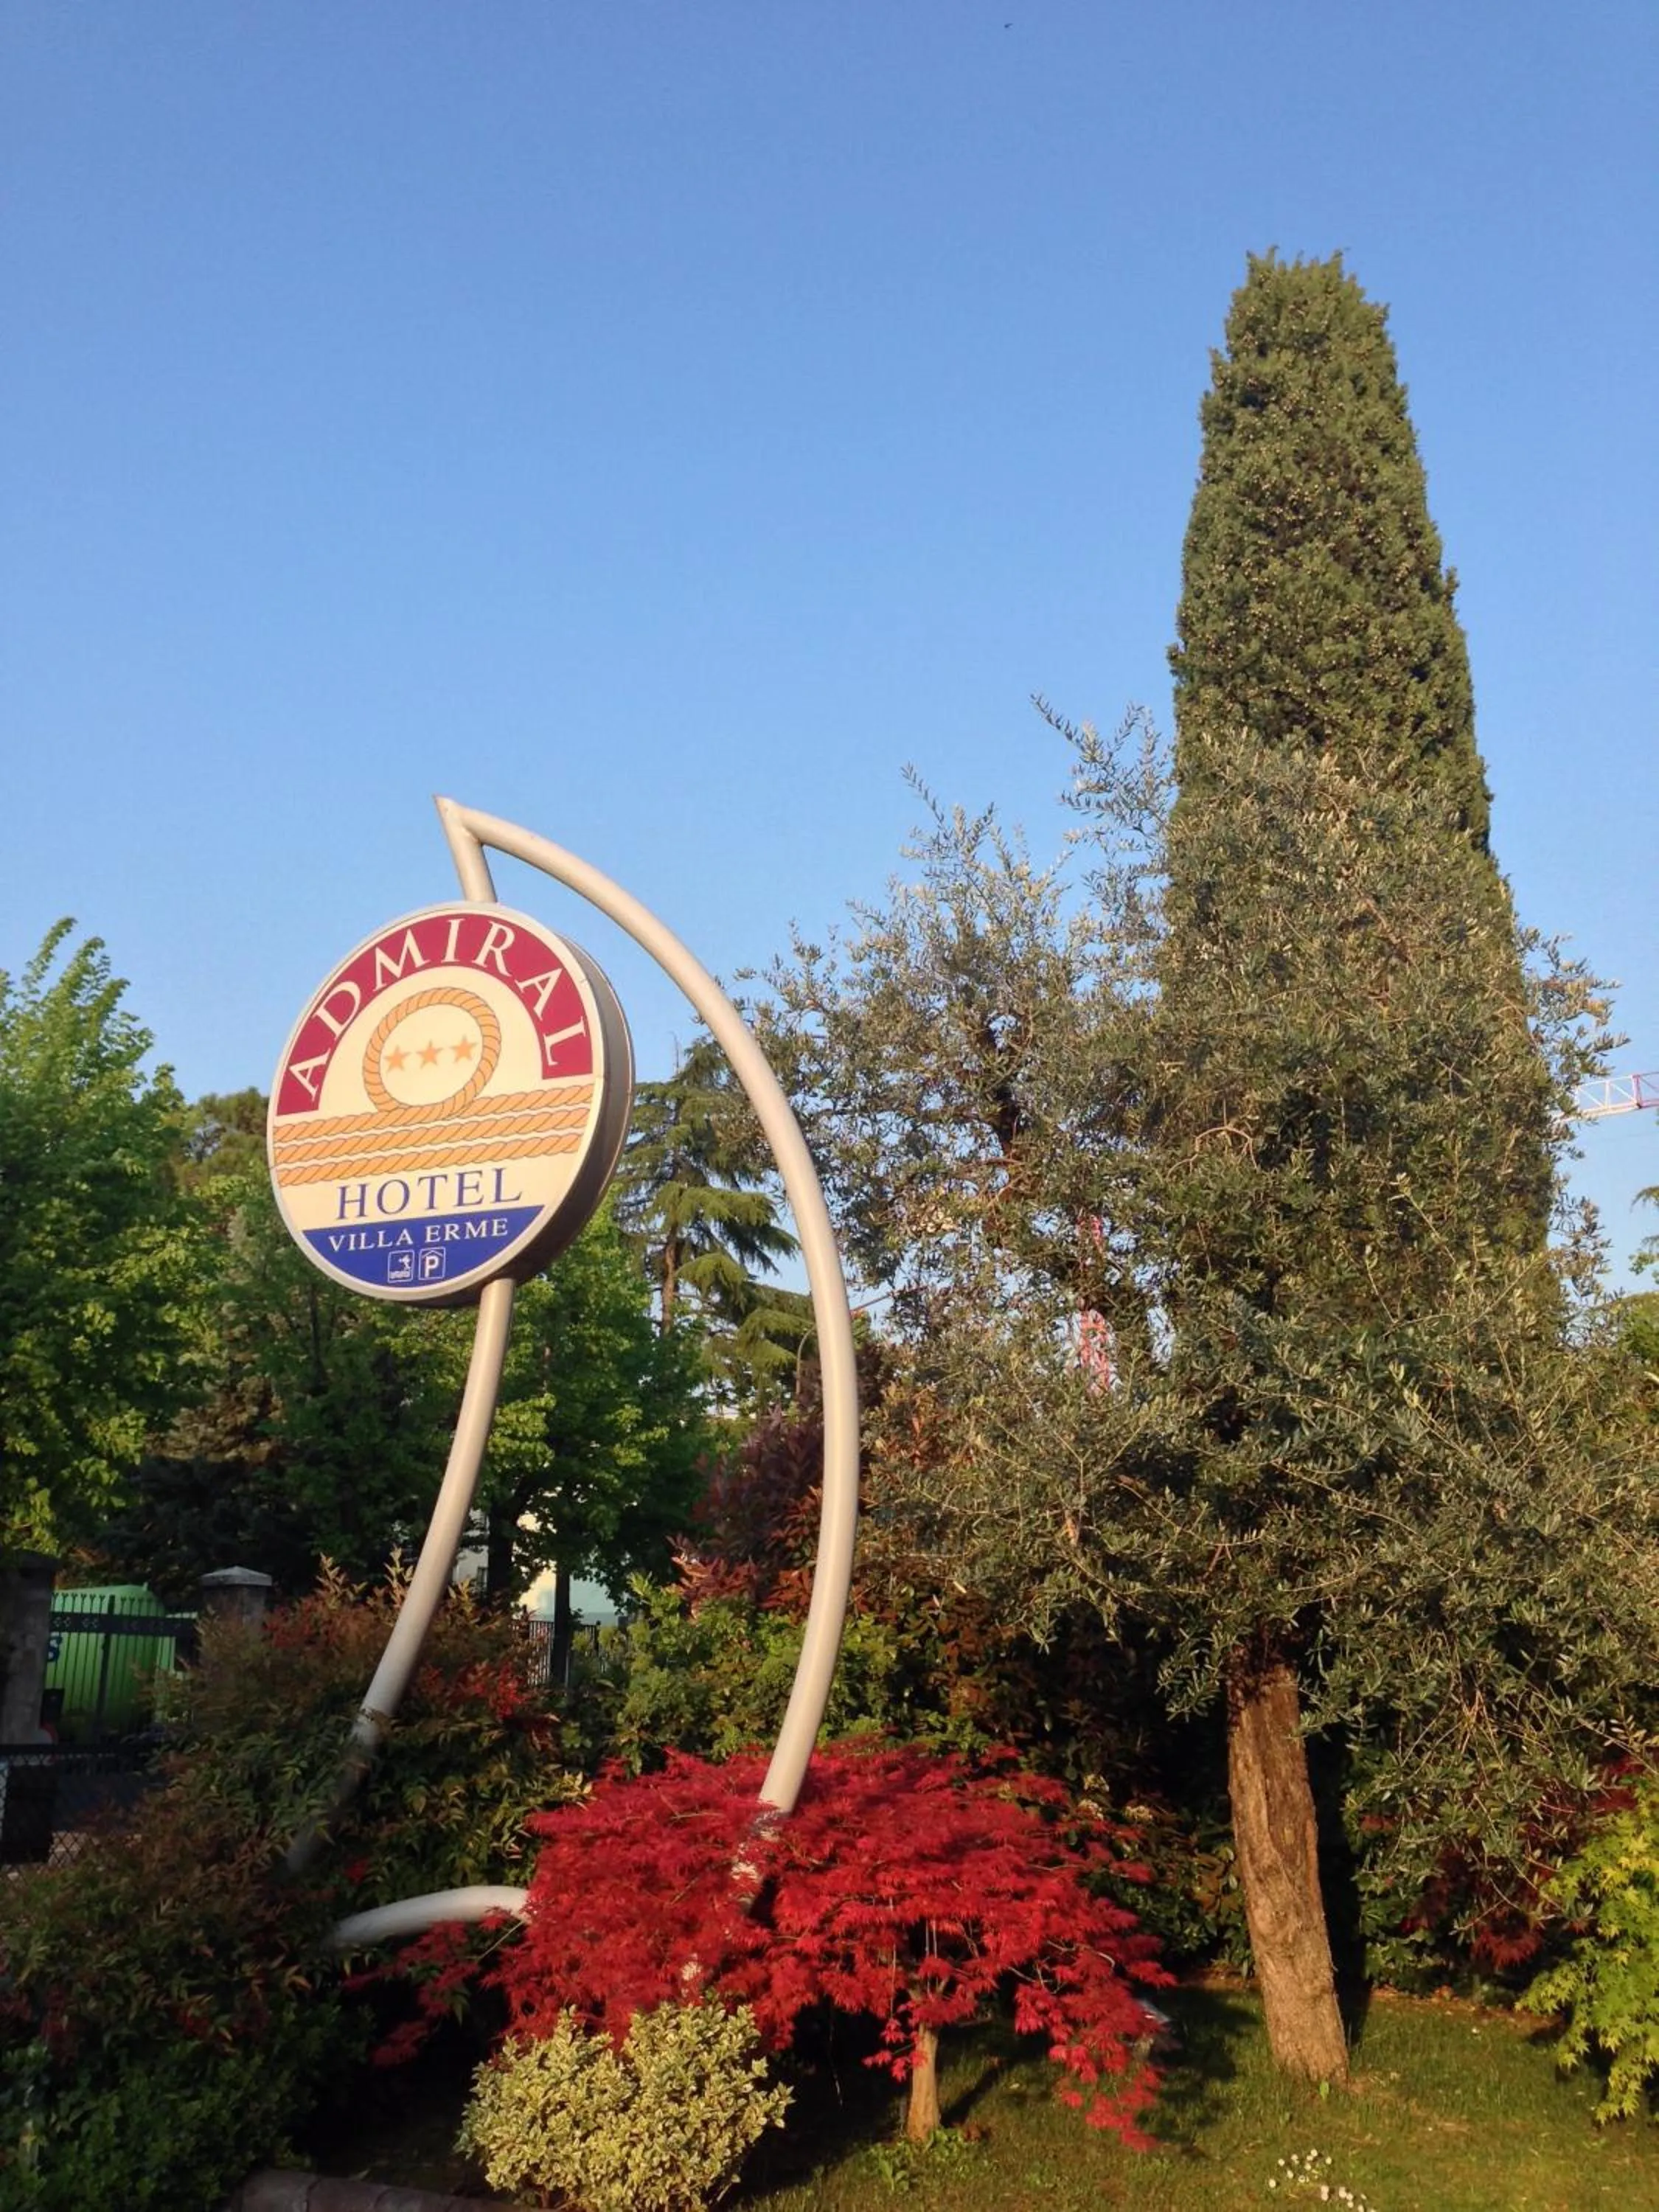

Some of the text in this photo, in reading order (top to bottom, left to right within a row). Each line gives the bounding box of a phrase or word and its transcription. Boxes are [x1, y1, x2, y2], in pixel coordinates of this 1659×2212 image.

[289, 919, 587, 1101] ADMIRAL
[336, 1167, 523, 1220] HOTEL
[328, 1218, 509, 1252] VILLA ERME
[424, 1255, 439, 1278] P
